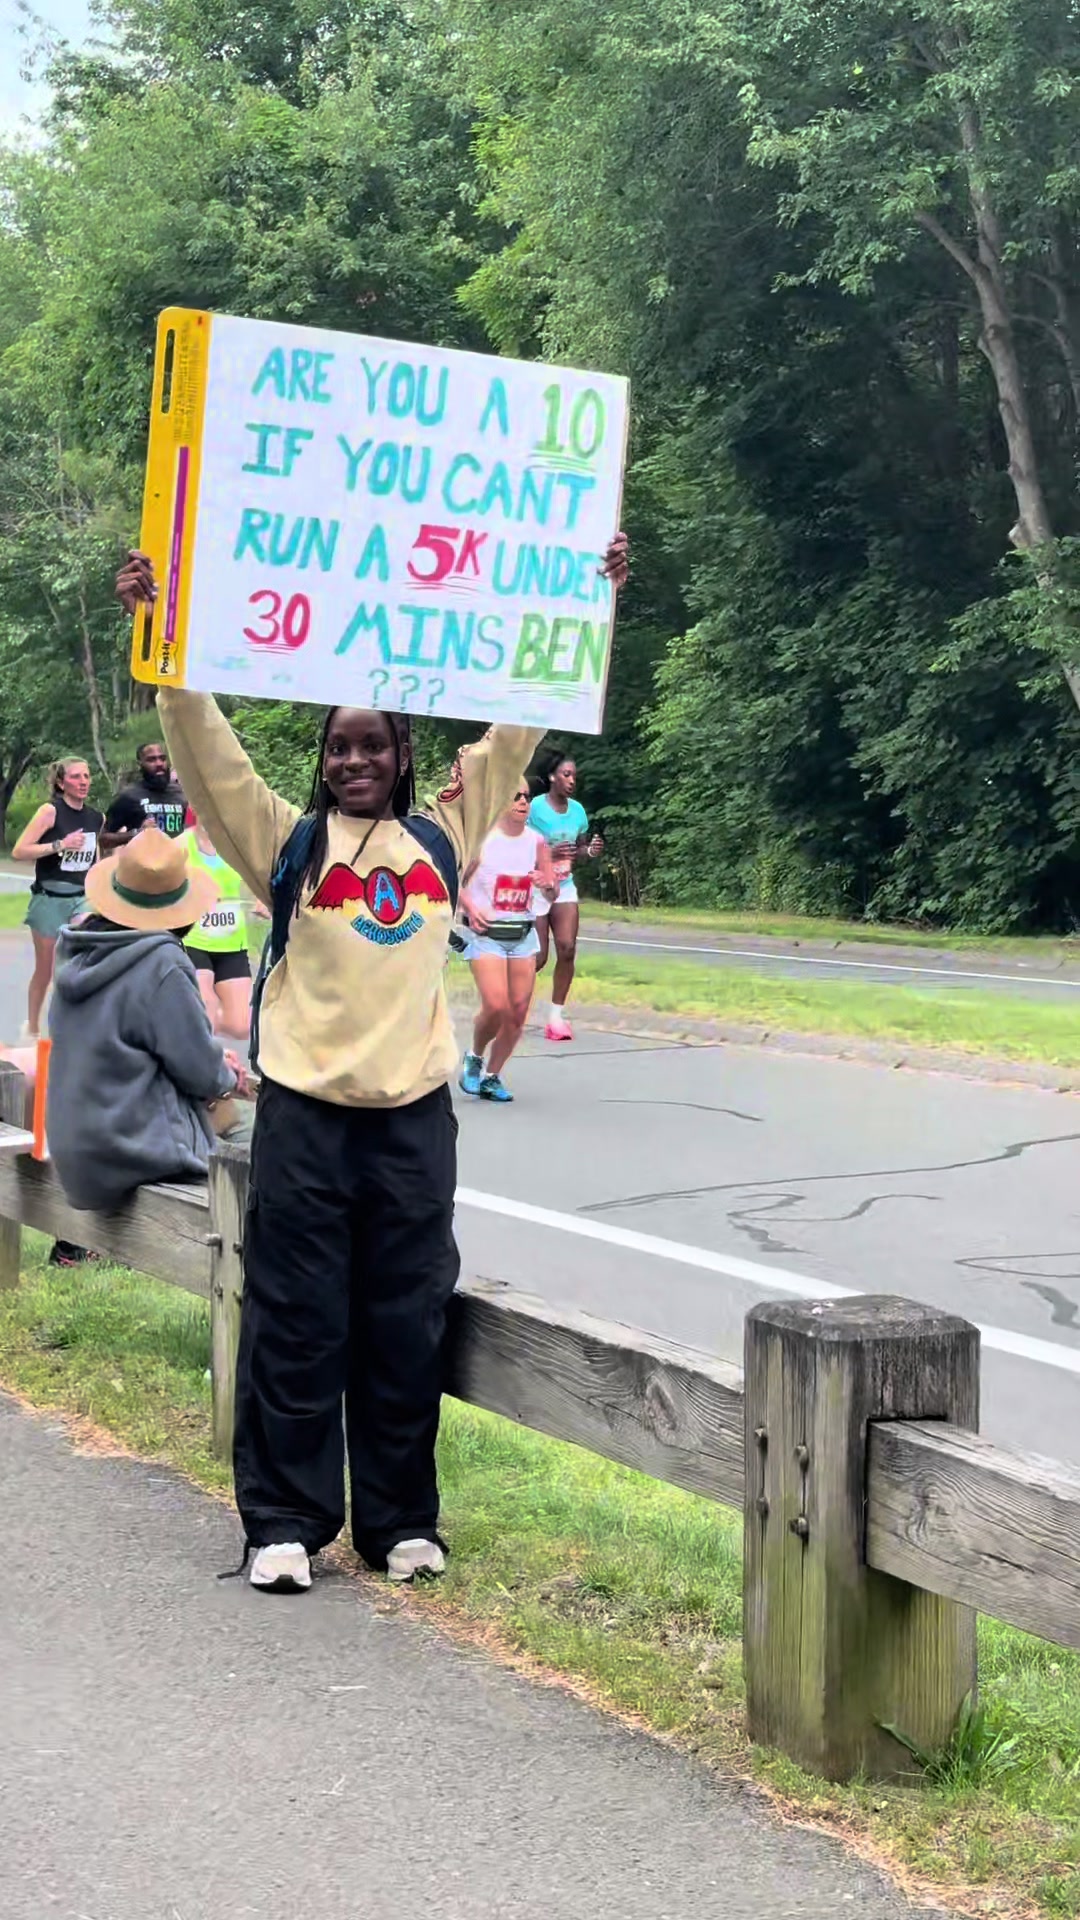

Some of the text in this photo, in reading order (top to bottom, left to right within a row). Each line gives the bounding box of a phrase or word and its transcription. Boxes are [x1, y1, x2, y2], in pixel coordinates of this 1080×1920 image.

[251, 346, 334, 403] ARE
[361, 357, 449, 426] YOU
[478, 376, 509, 436] A
[535, 383, 606, 458] 10
[242, 423, 596, 530] IF YOU CANT
[233, 507, 340, 572] RUN
[354, 523, 390, 583] A
[406, 523, 488, 582] 5K
[243, 589, 609, 683] 30 MINS BEN
[64, 850, 93, 863] 2418
[373, 871, 400, 913] A
[202, 911, 236, 927] 2009
